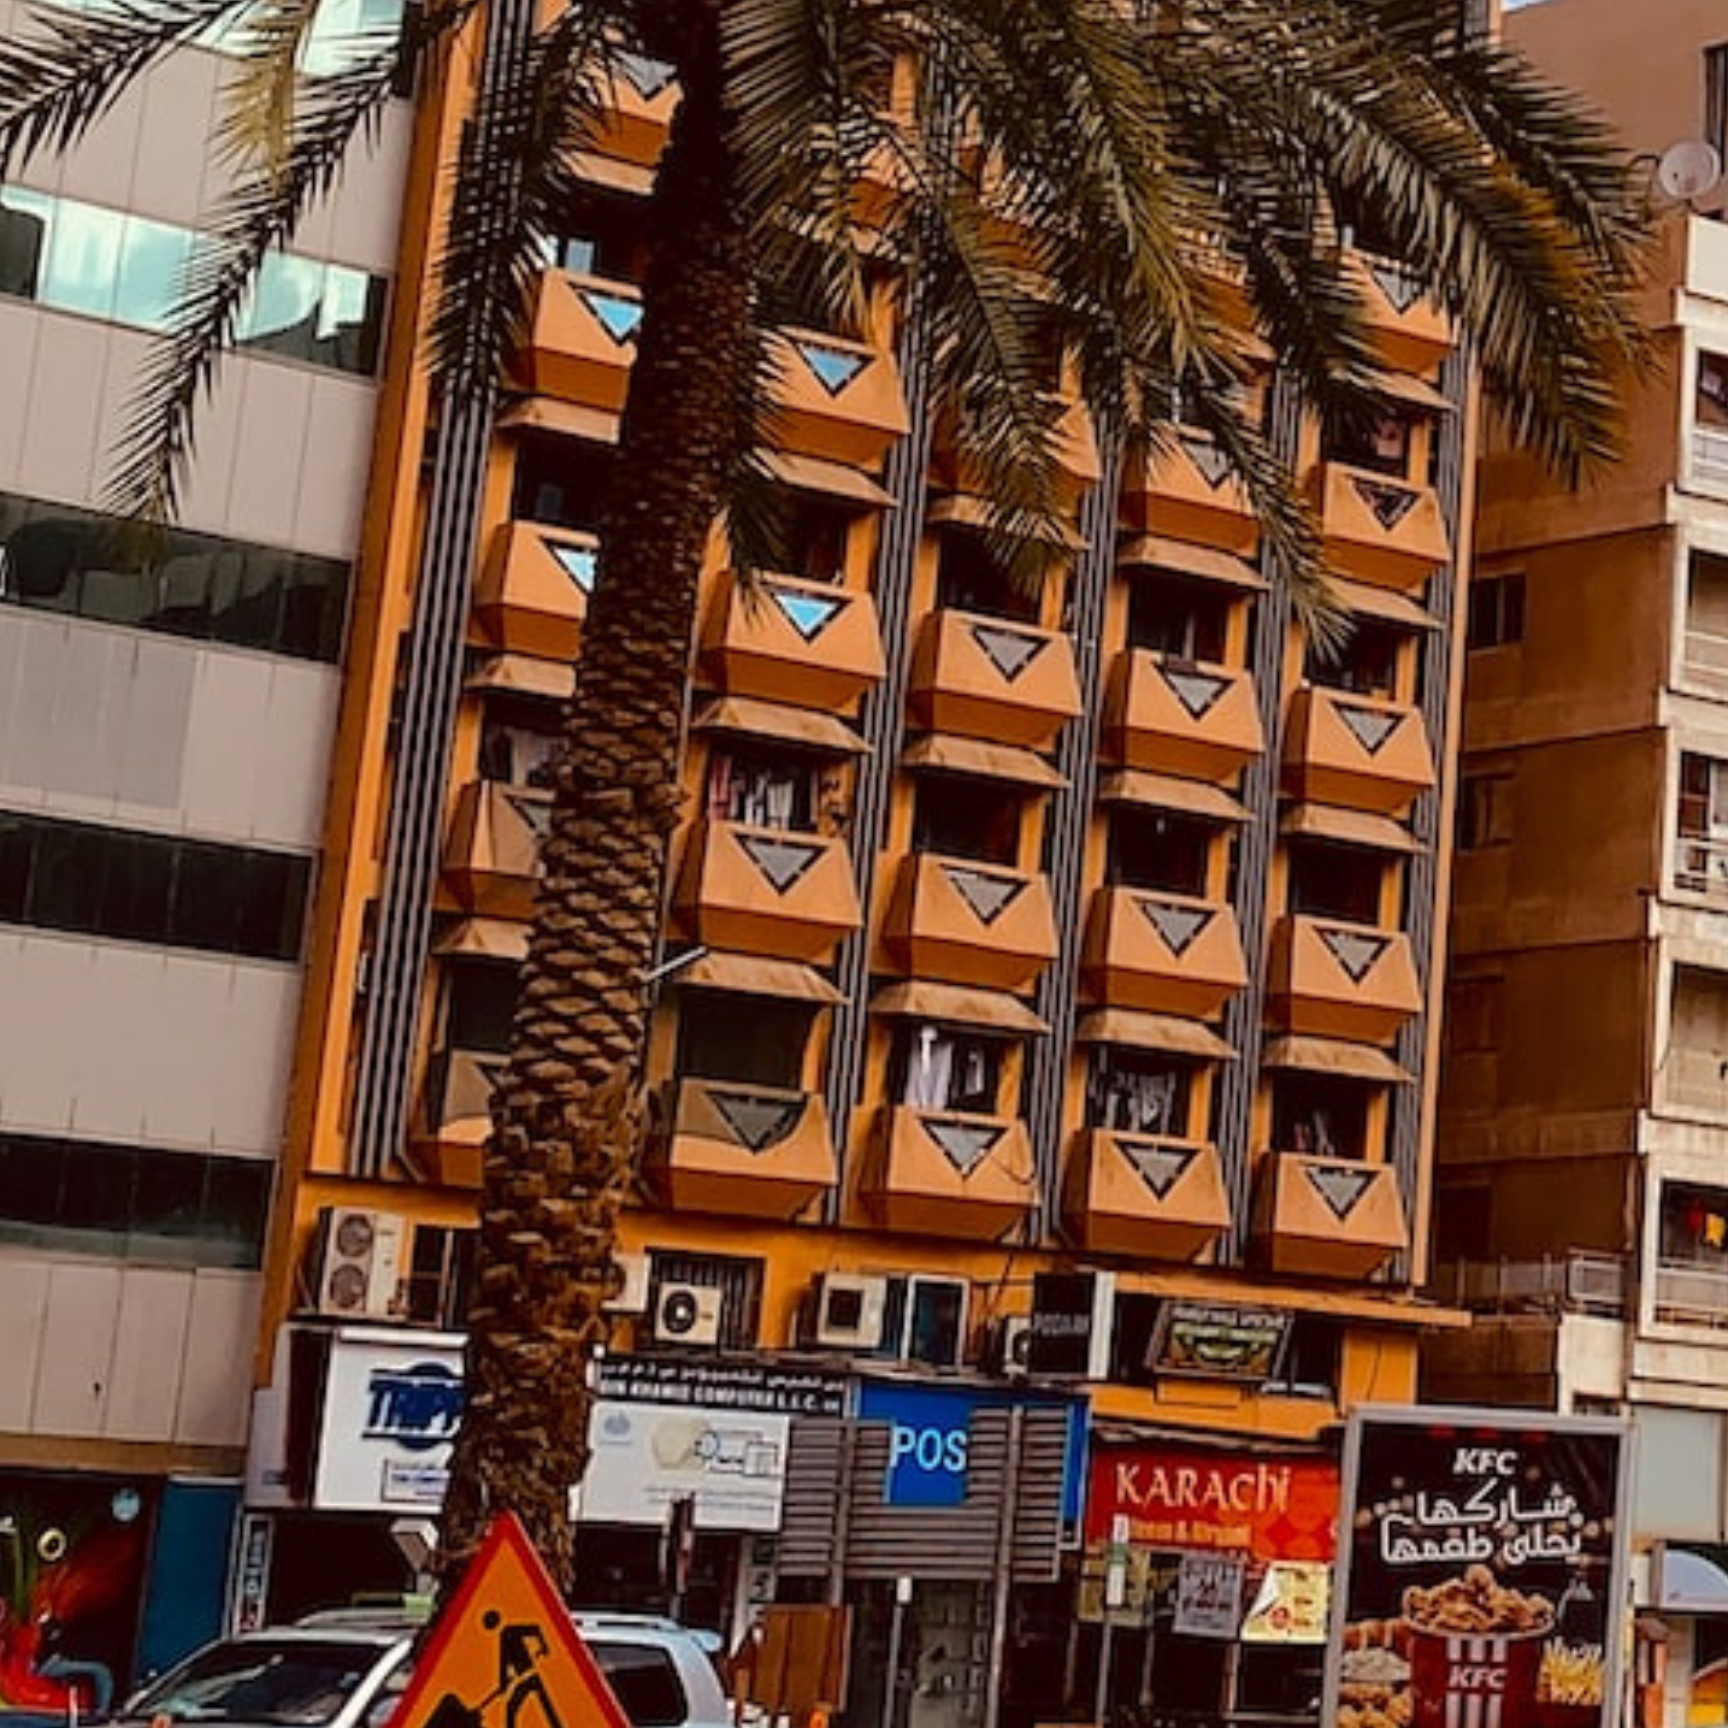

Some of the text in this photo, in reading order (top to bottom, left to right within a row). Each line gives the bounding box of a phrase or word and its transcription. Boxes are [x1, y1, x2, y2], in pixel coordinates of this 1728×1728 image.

[890, 1425, 968, 1472] POS
[1453, 1447, 1518, 1475] KFC
[1448, 1665, 1507, 1689] KFC
